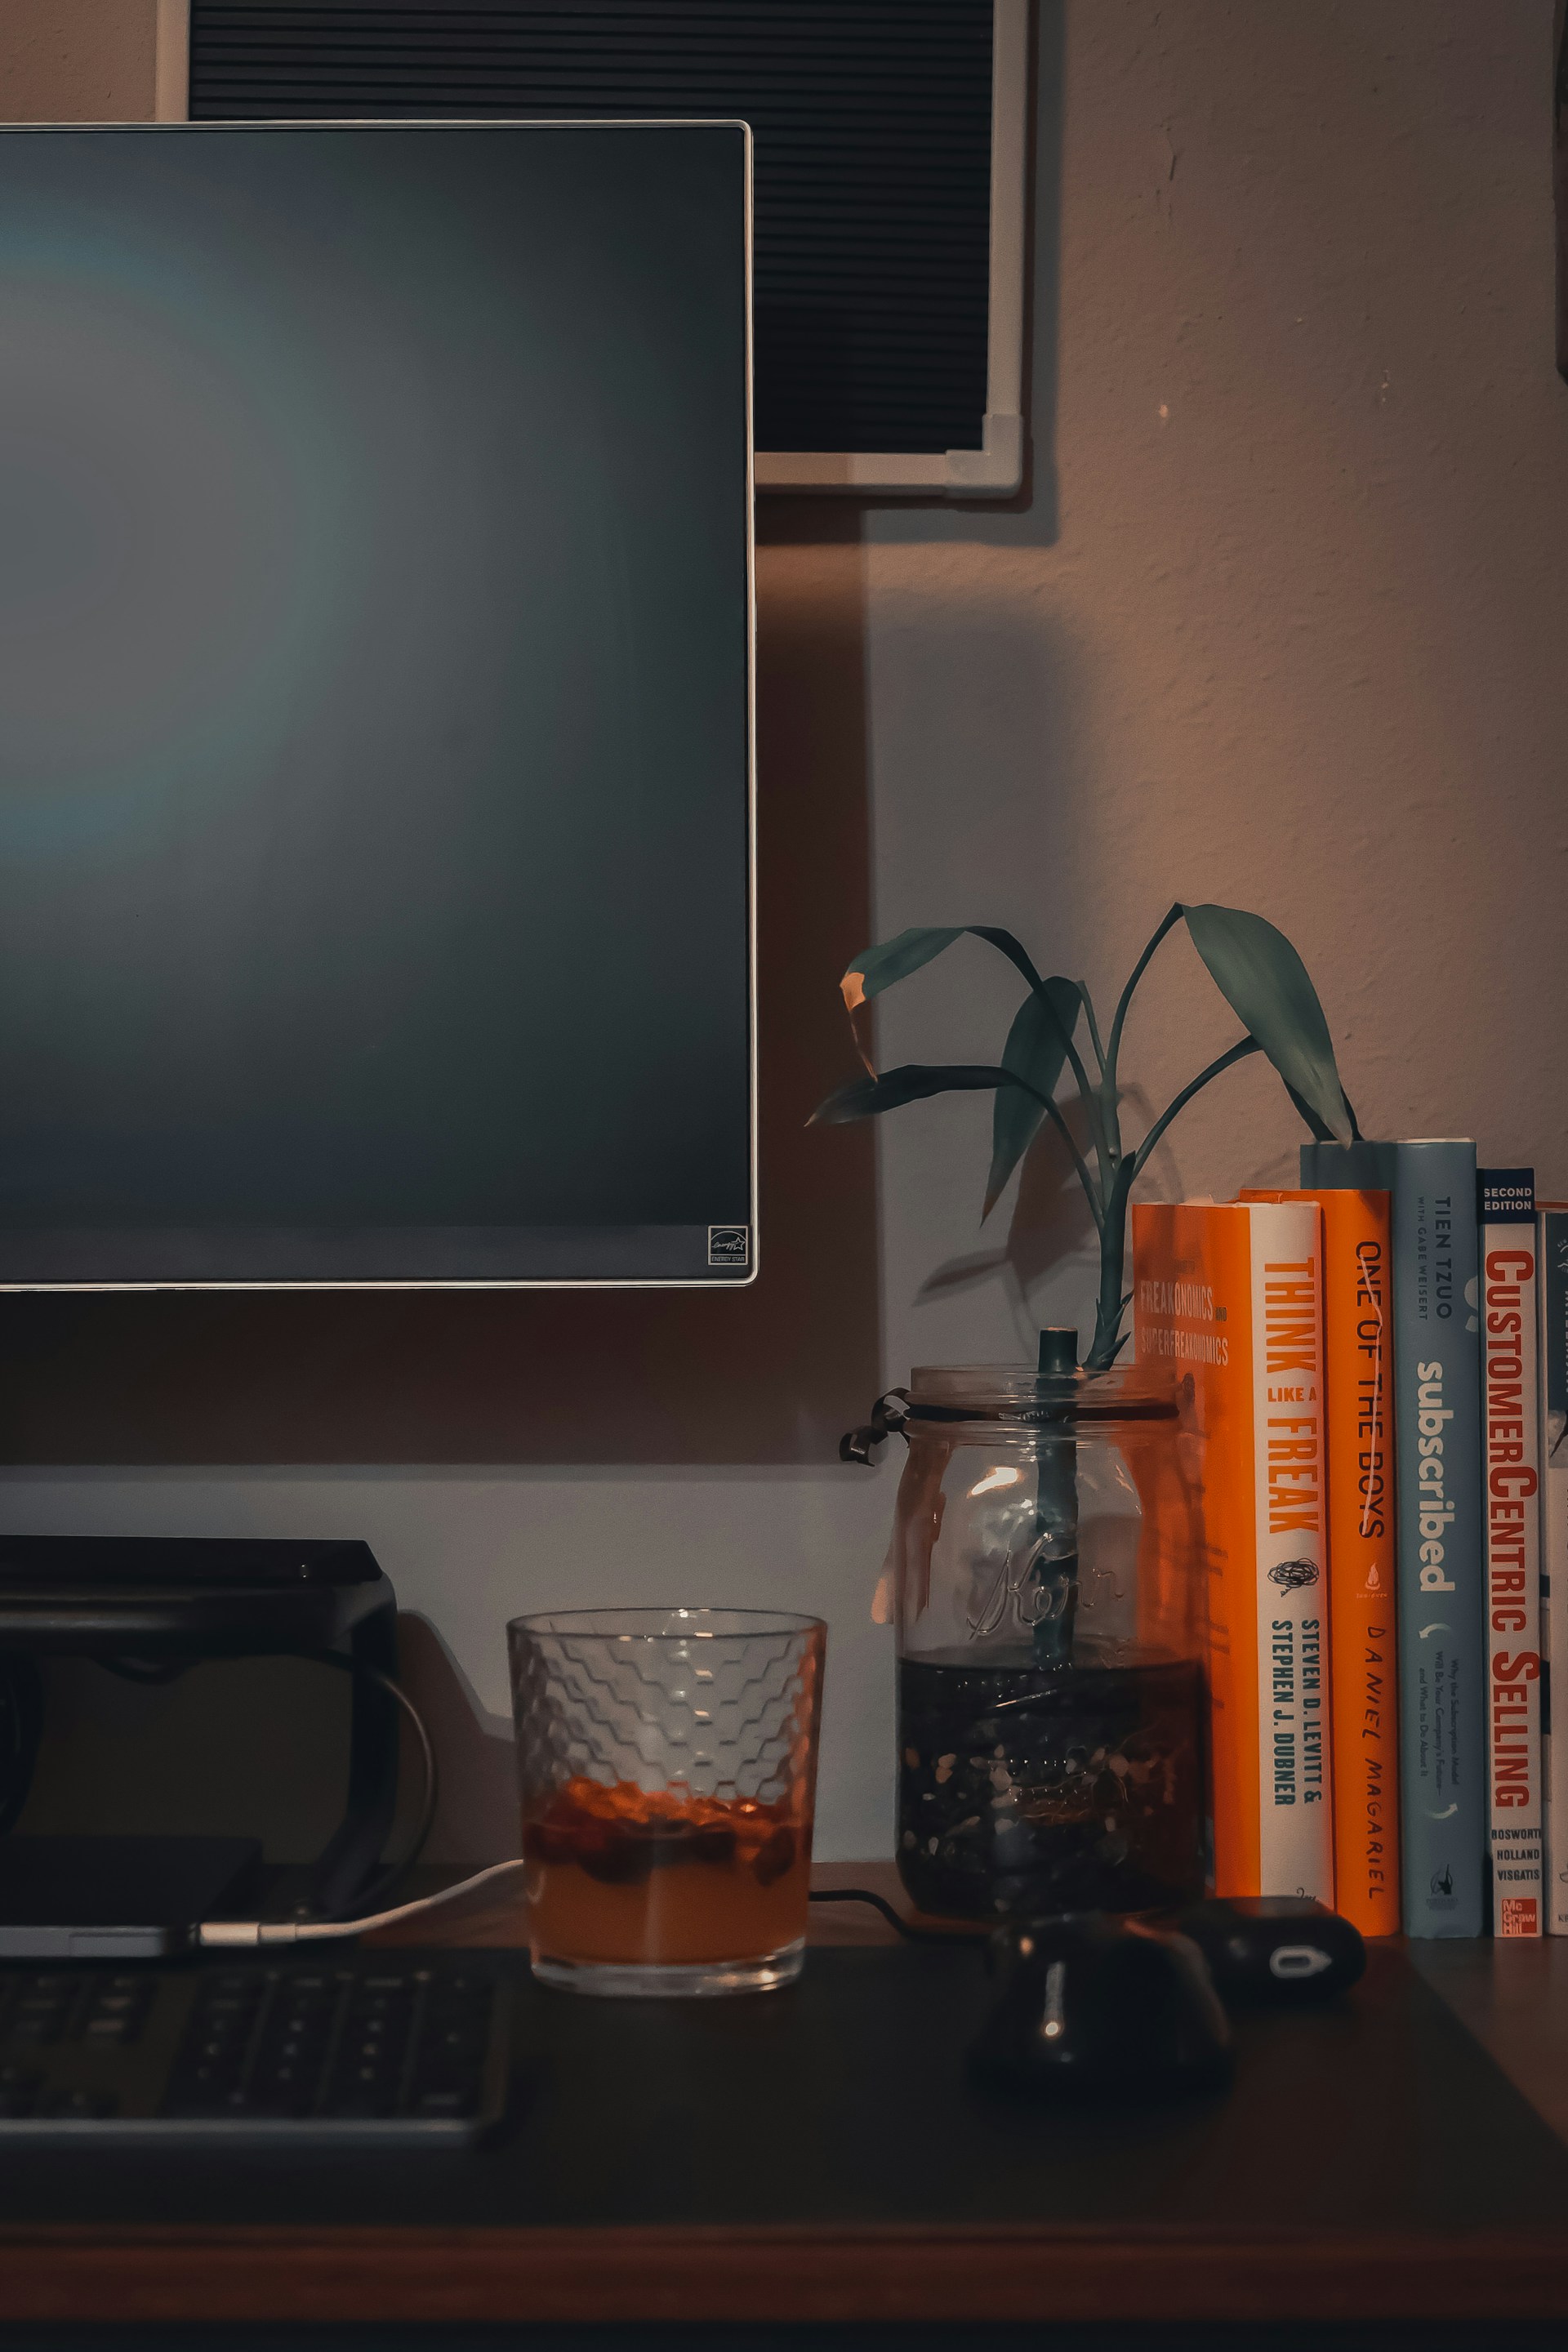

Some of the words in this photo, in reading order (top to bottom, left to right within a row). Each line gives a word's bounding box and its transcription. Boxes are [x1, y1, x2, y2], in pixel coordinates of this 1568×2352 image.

[1417, 1196, 1426, 1223] WITH
[1483, 1187, 1532, 1198] SECOND
[1483, 1200, 1532, 1211] EDITION
[1417, 1227, 1428, 1261] GABE
[1435, 1196, 1451, 1249] TIEN
[1140, 1280, 1214, 1321] FREAKONOMICS
[1355, 1241, 1383, 1307] ONE
[1418, 1265, 1428, 1321] WEISERT
[1436, 1258, 1452, 1320] TZUO
[1264, 1257, 1316, 1374] THINK
[1356, 1319, 1383, 1361] OF
[1267, 1387, 1304, 1403] LIKE
[1307, 1387, 1317, 1402] A
[1357, 1370, 1384, 1439] THE
[1267, 1417, 1320, 1535] FREAK
[1358, 1451, 1385, 1539] BOYS
[1416, 1361, 1456, 1592] subscribed
[1271, 1619, 1294, 1704] STEPHEN
[1301, 1619, 1321, 1690] STEVEN
[1303, 1697, 1321, 1716] D.
[1361, 1626, 1387, 1740] DANIEL
[1272, 1709, 1294, 1727] J.
[1273, 1732, 1296, 1806] DUBNER
[1303, 1722, 1322, 1785] LEVITT
[1303, 1790, 1322, 1804] &
[1363, 1757, 1385, 1900] MAGARIEL
[1497, 1848, 1540, 1861] HOLLAND
[1497, 1869, 1540, 1882] VISGATIS
